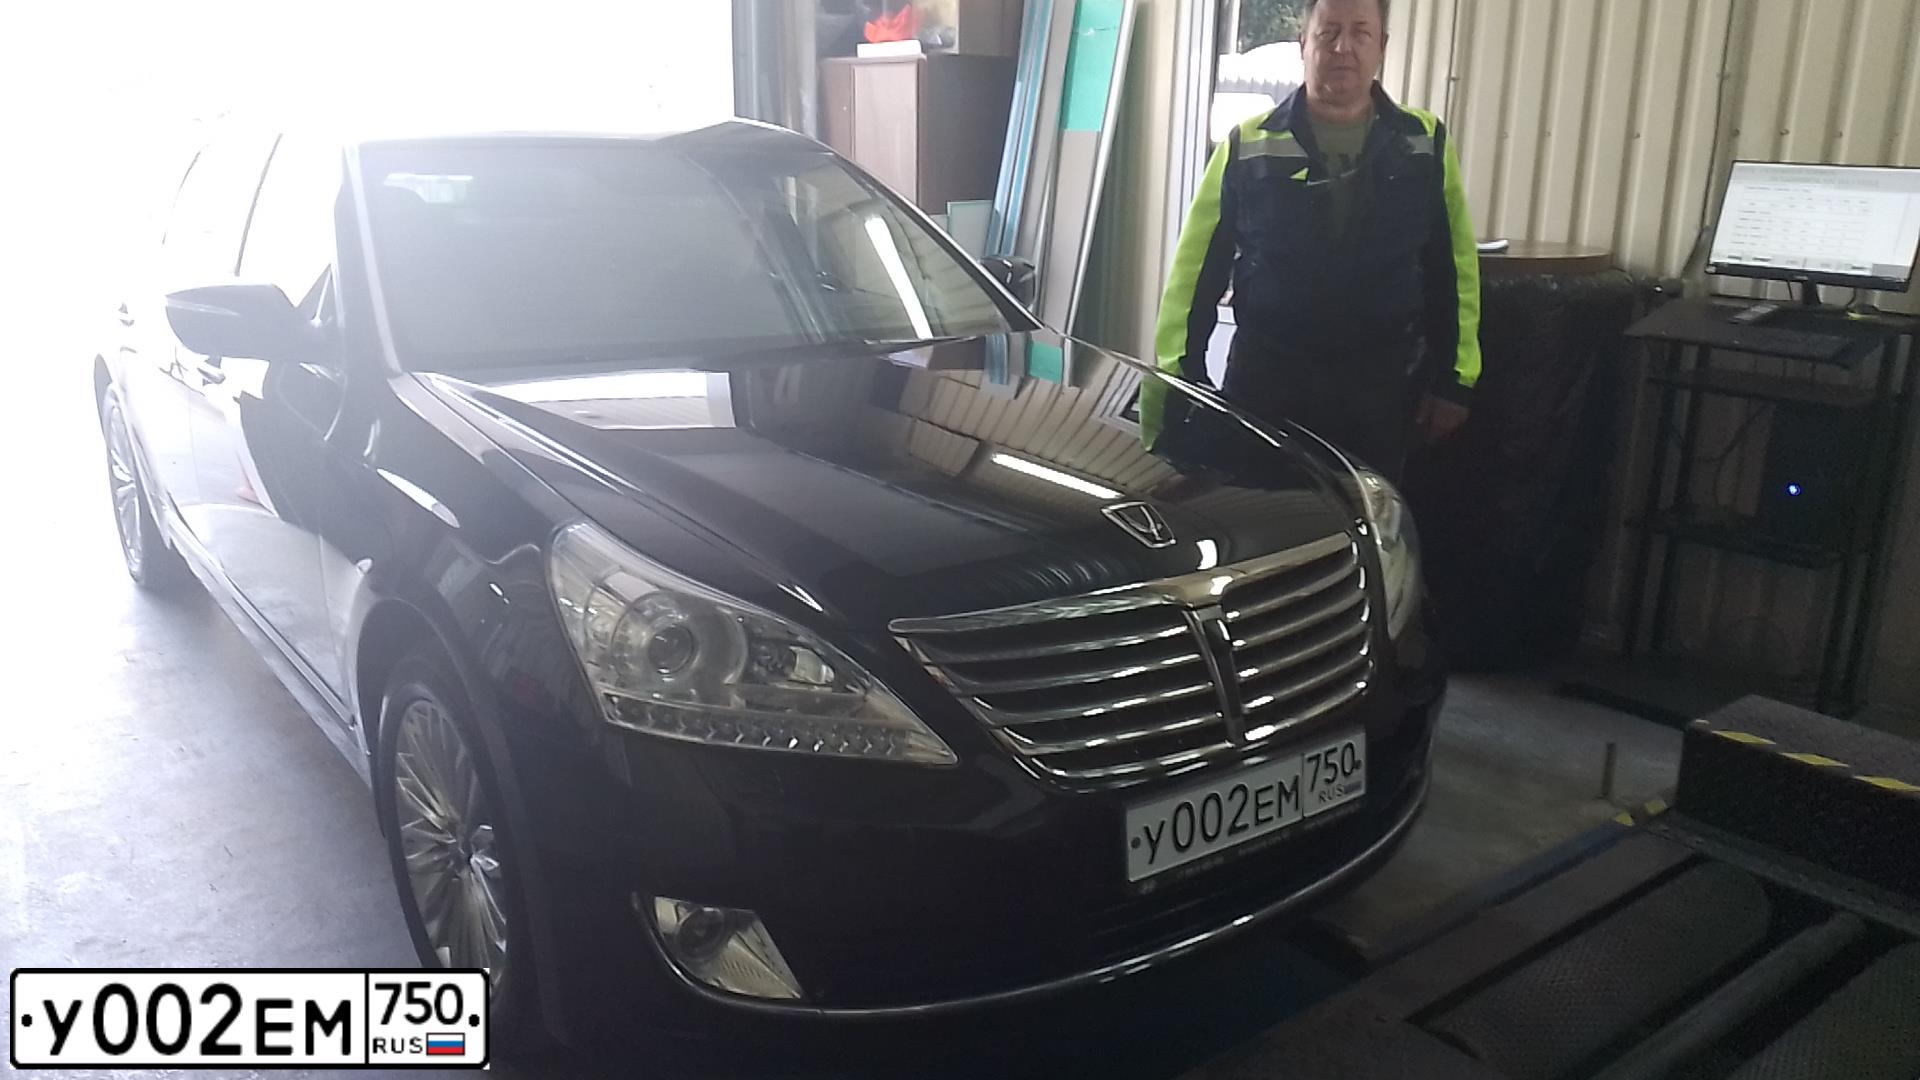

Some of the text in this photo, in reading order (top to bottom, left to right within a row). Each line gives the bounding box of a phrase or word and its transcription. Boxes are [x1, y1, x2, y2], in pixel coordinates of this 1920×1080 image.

[1143, 775, 1300, 865] У002ЕМ
[1306, 742, 1355, 792] 750
[1318, 784, 1344, 803] RUS
